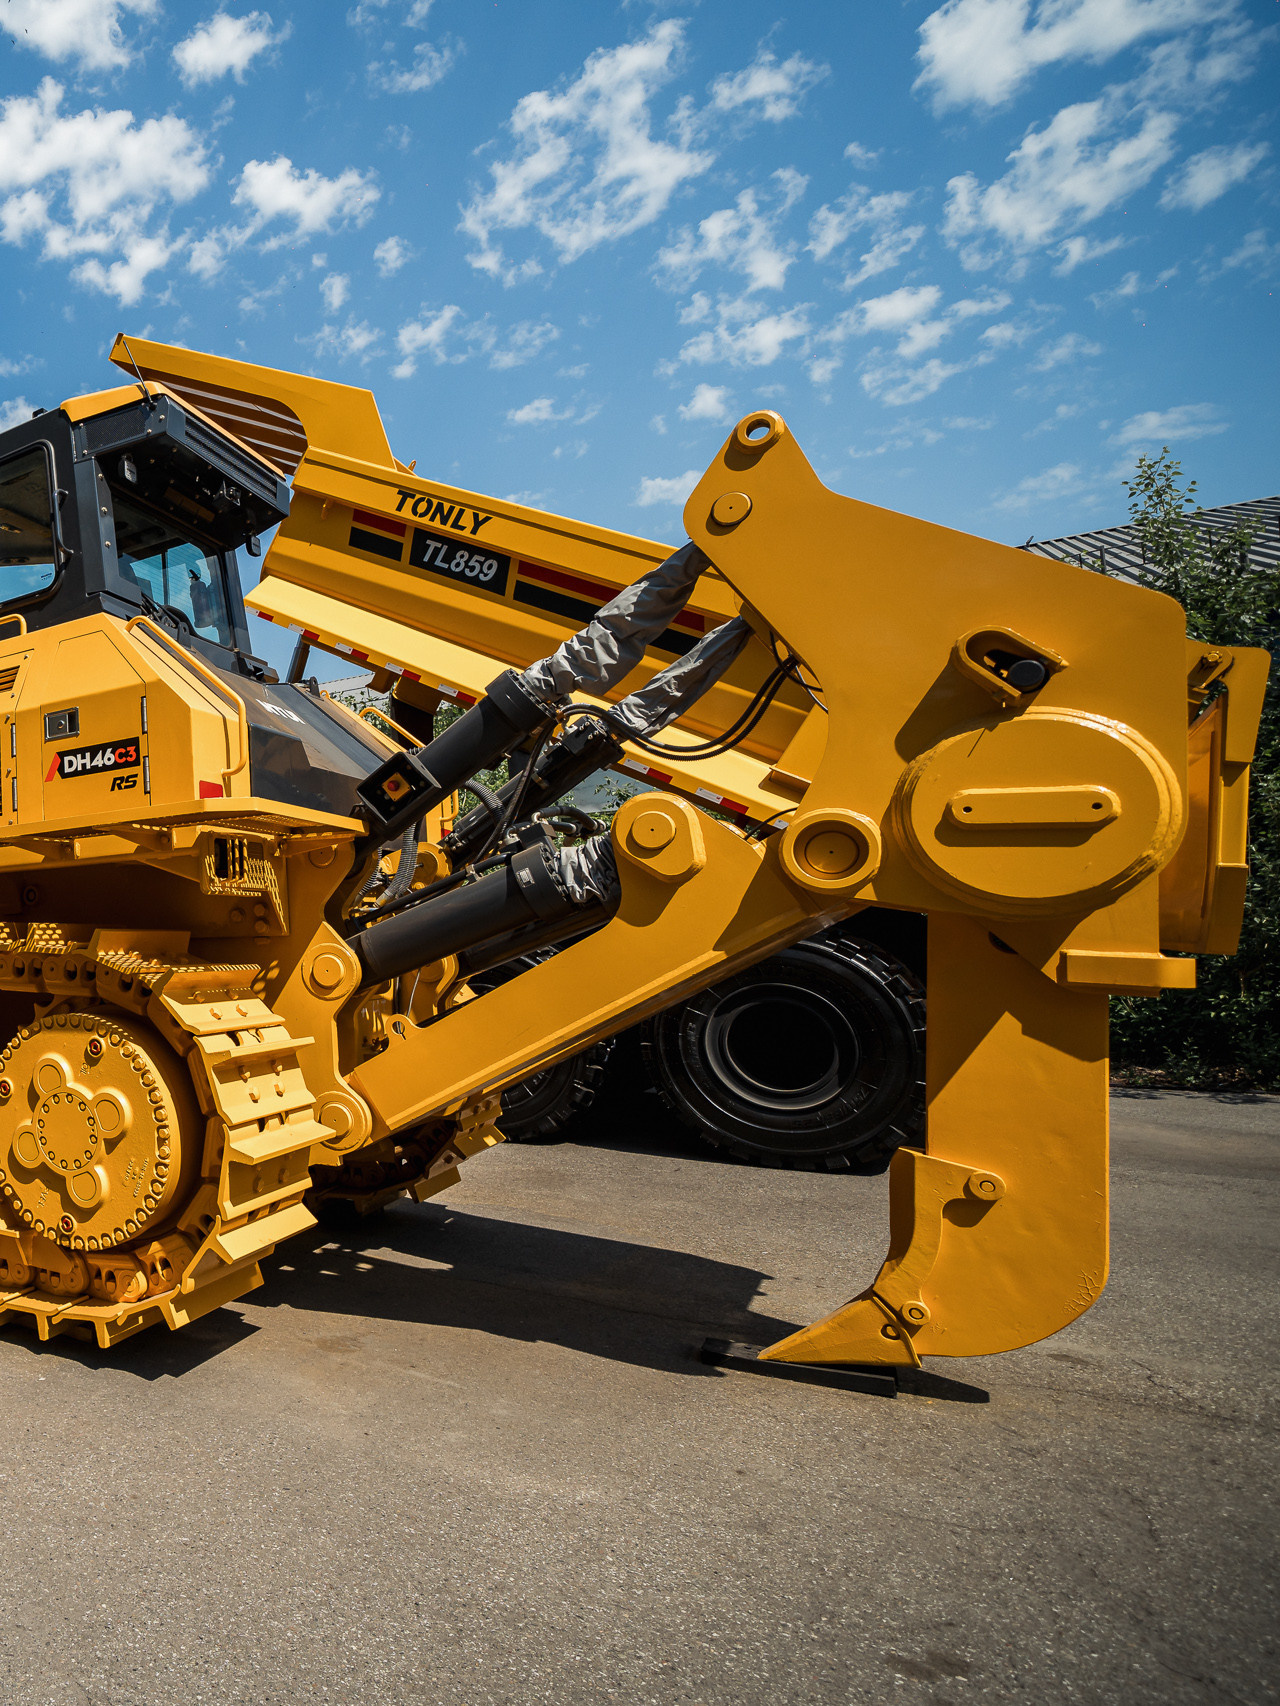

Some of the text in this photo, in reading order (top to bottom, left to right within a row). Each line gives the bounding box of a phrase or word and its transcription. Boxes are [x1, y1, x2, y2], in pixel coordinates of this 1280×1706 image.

[395, 489, 494, 536] TONLY
[423, 539, 499, 582] TL859
[63, 746, 137, 774] DH46C3
[110, 773, 139, 792] RS
